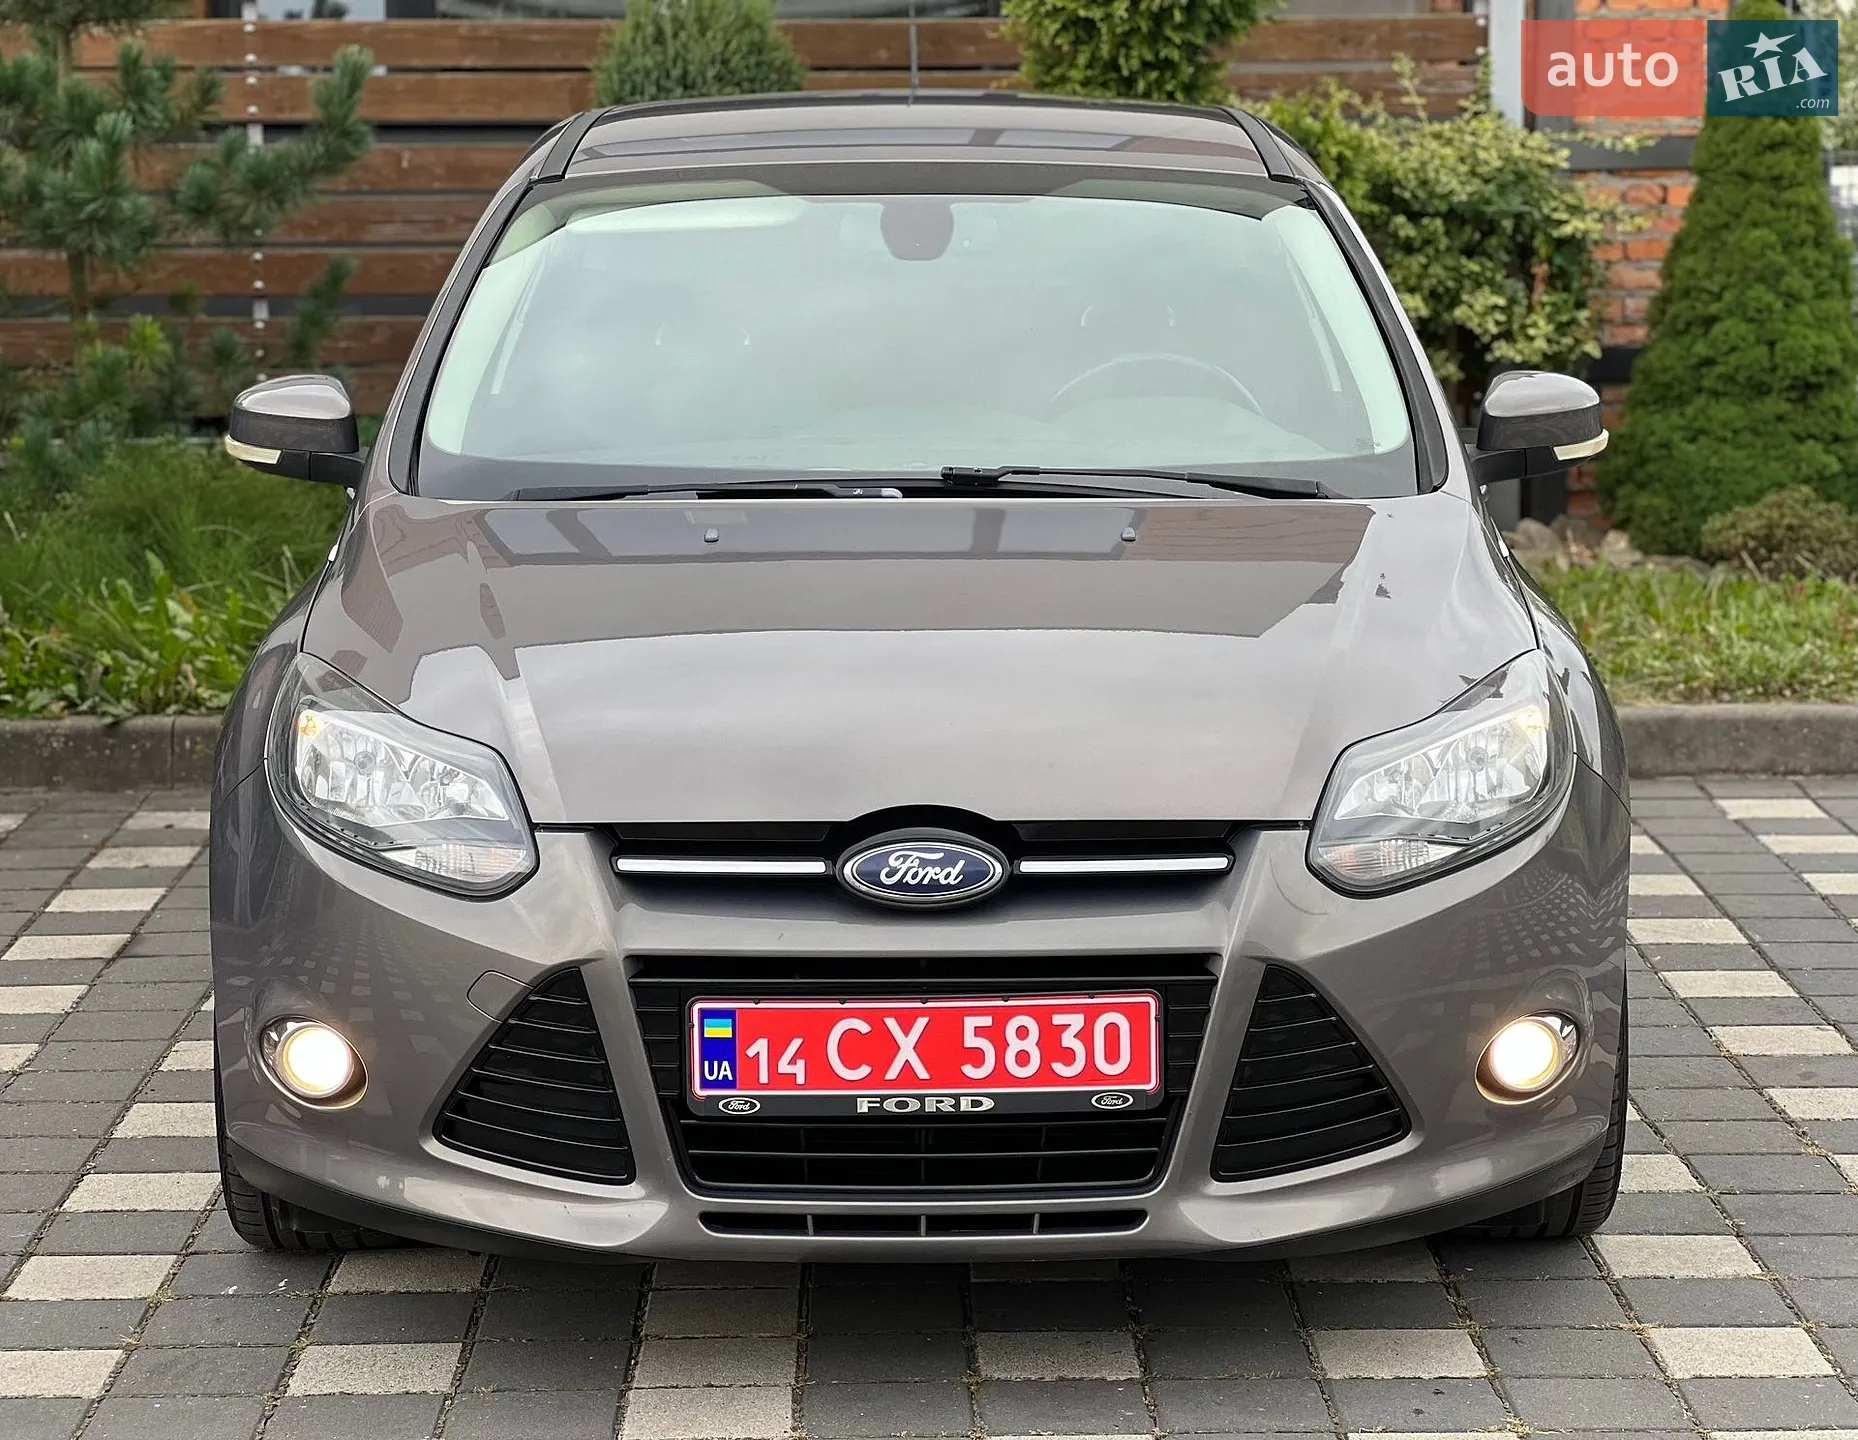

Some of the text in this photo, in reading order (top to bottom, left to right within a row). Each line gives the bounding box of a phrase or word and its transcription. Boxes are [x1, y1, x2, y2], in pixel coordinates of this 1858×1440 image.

[879, 850, 966, 885] Ford
[744, 1011, 1132, 1084] 14 CX 5830
[703, 1060, 733, 1081] UA
[727, 1100, 751, 1111] Ford
[856, 1096, 996, 1113] FORD
[1100, 1095, 1124, 1106] Ford
